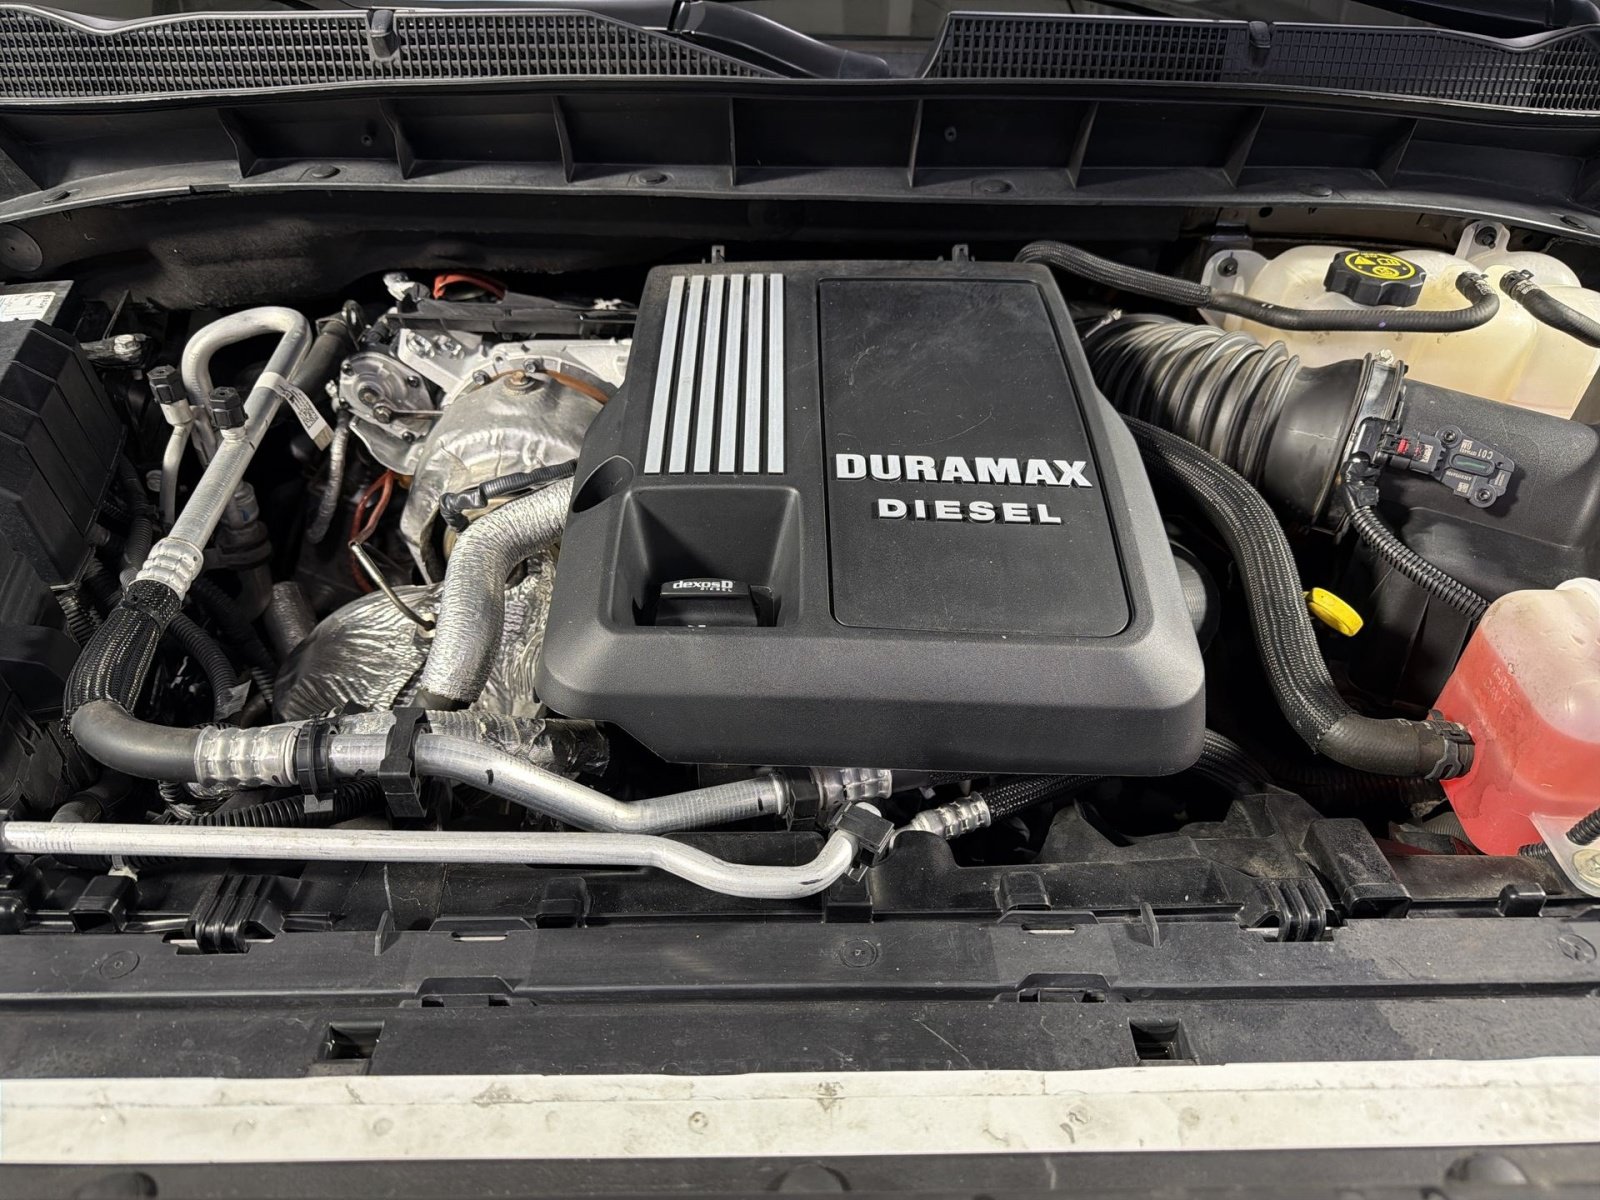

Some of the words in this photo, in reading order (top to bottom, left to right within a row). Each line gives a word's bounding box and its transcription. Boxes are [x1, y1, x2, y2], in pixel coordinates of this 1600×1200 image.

[1478, 448, 1494, 460] C01
[835, 453, 1093, 488] DURAMAX
[877, 498, 1062, 524] DIESEL
